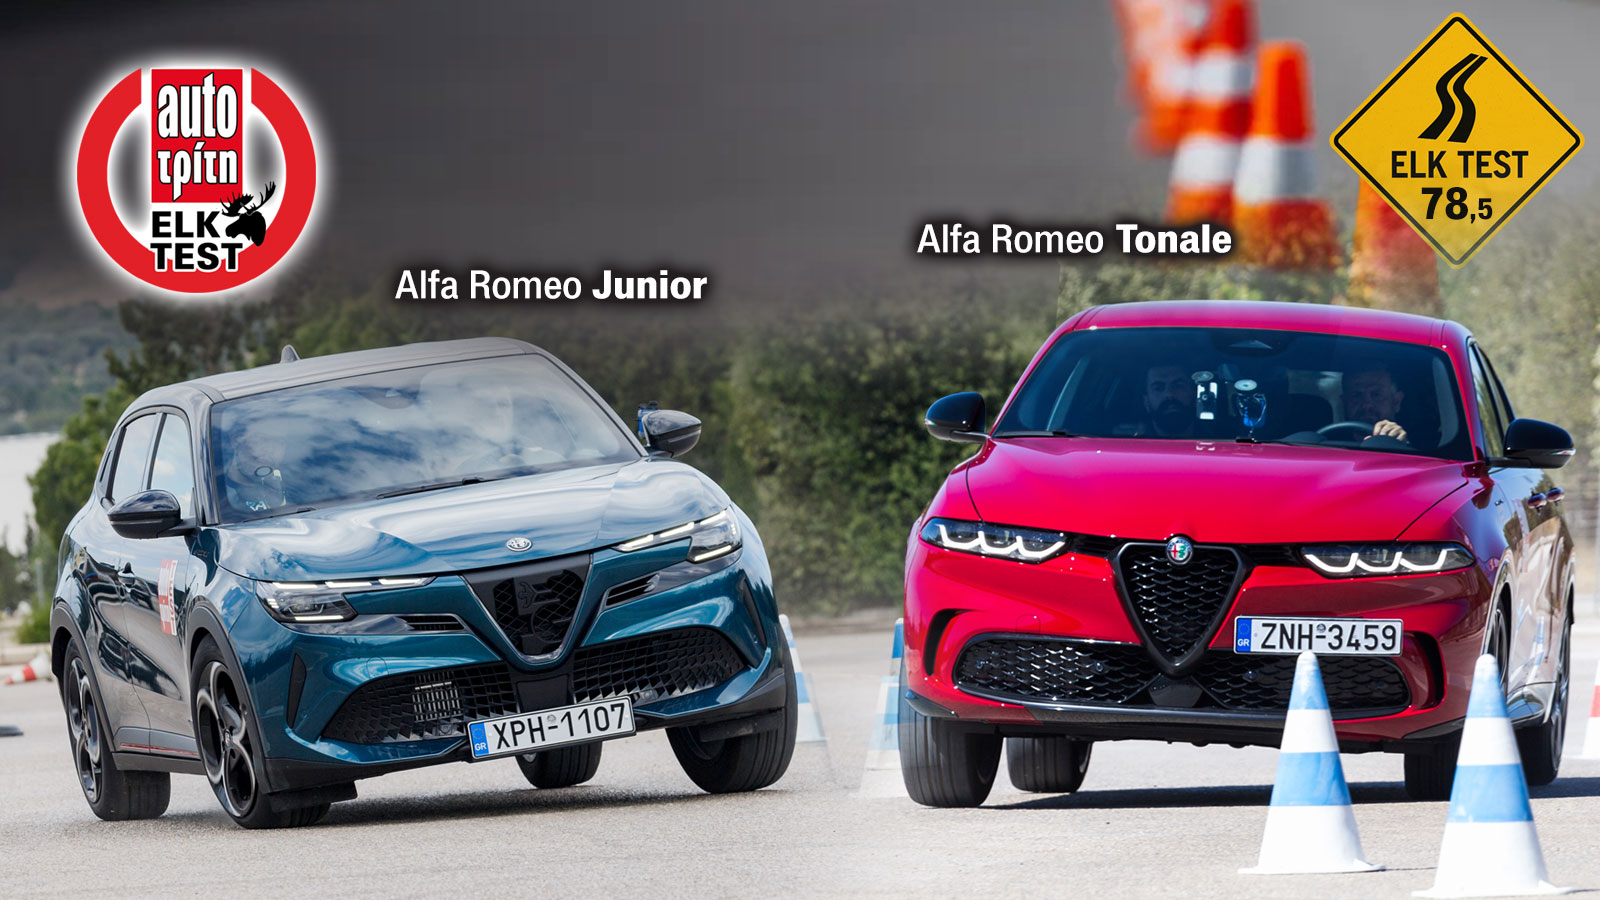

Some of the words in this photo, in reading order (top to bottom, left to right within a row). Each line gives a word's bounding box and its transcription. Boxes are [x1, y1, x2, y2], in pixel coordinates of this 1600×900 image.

[1237, 638, 1250, 647] GR
[1260, 623, 1397, 651] ZNH-3459
[493, 702, 625, 750] XPH-1107
[474, 742, 487, 751] GR
